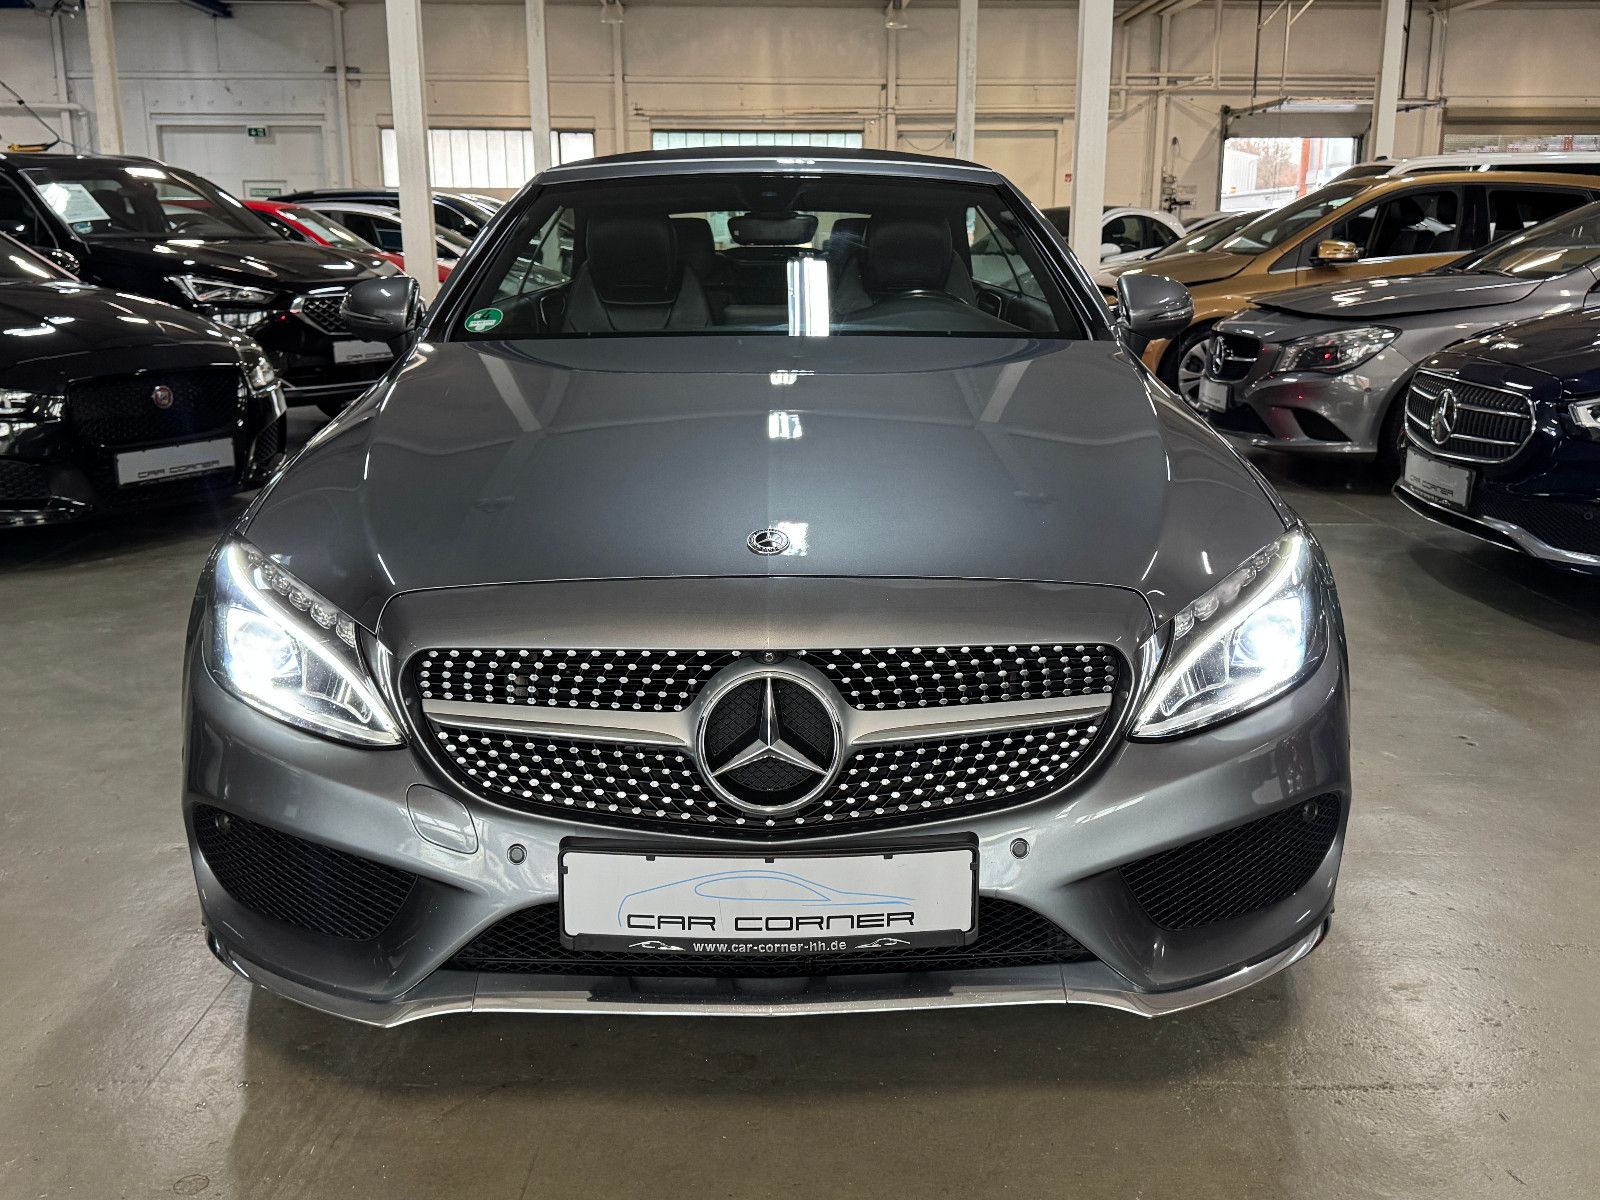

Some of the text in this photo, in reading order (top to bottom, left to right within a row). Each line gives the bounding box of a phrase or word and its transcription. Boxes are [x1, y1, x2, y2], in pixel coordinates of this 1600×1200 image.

[627, 911, 915, 931] CAR CORNER
[692, 940, 847, 953] www.car-corner-hh.de
